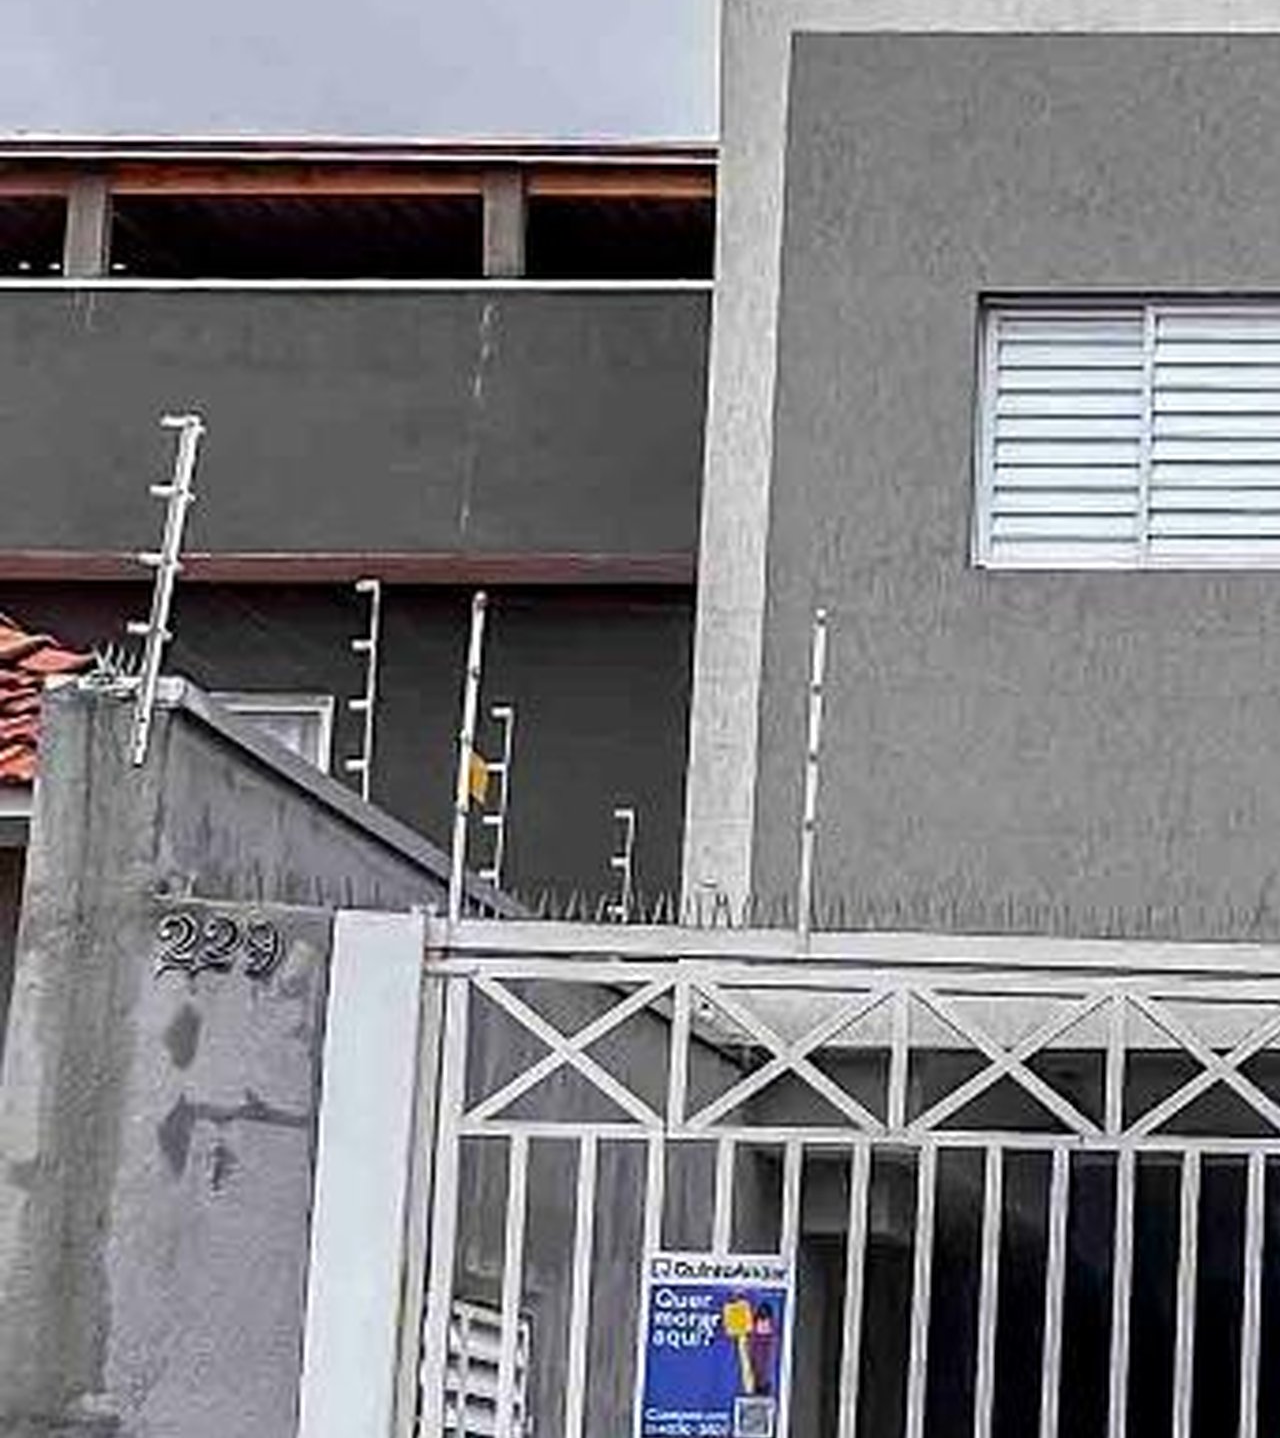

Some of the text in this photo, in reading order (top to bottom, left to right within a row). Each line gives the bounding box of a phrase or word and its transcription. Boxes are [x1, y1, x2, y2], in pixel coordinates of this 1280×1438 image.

[154, 914, 284, 979] 229
[655, 1288, 713, 1308] Quer
[653, 1327, 714, 1350] aqui?
